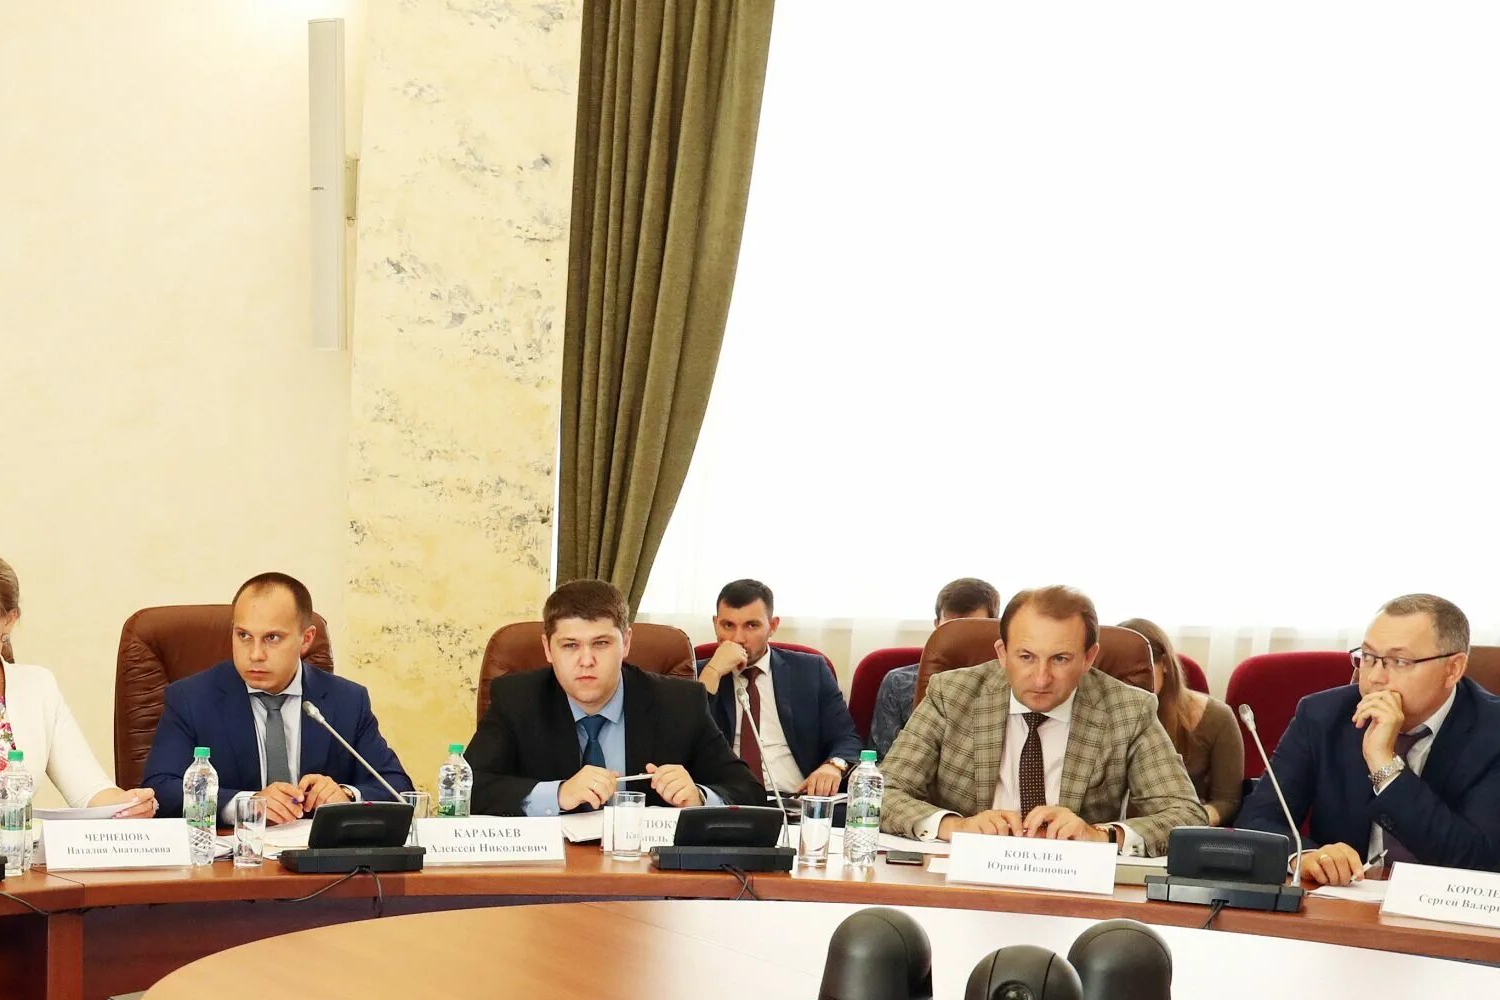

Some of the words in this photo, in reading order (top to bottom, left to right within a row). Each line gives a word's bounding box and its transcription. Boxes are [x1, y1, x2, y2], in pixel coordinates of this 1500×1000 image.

[84, 833, 151, 843] ЧЕРНЕЦОВА
[452, 828, 521, 839] КАРАБАЕВ
[429, 843, 476, 854] Алексей
[479, 842, 548, 854] Николаевич
[1004, 850, 1063, 862] КОВАЛЕВ
[987, 861, 1020, 873] Юрий
[1023, 863, 1077, 876] Иванович
[1419, 894, 1458, 908] Сергей
